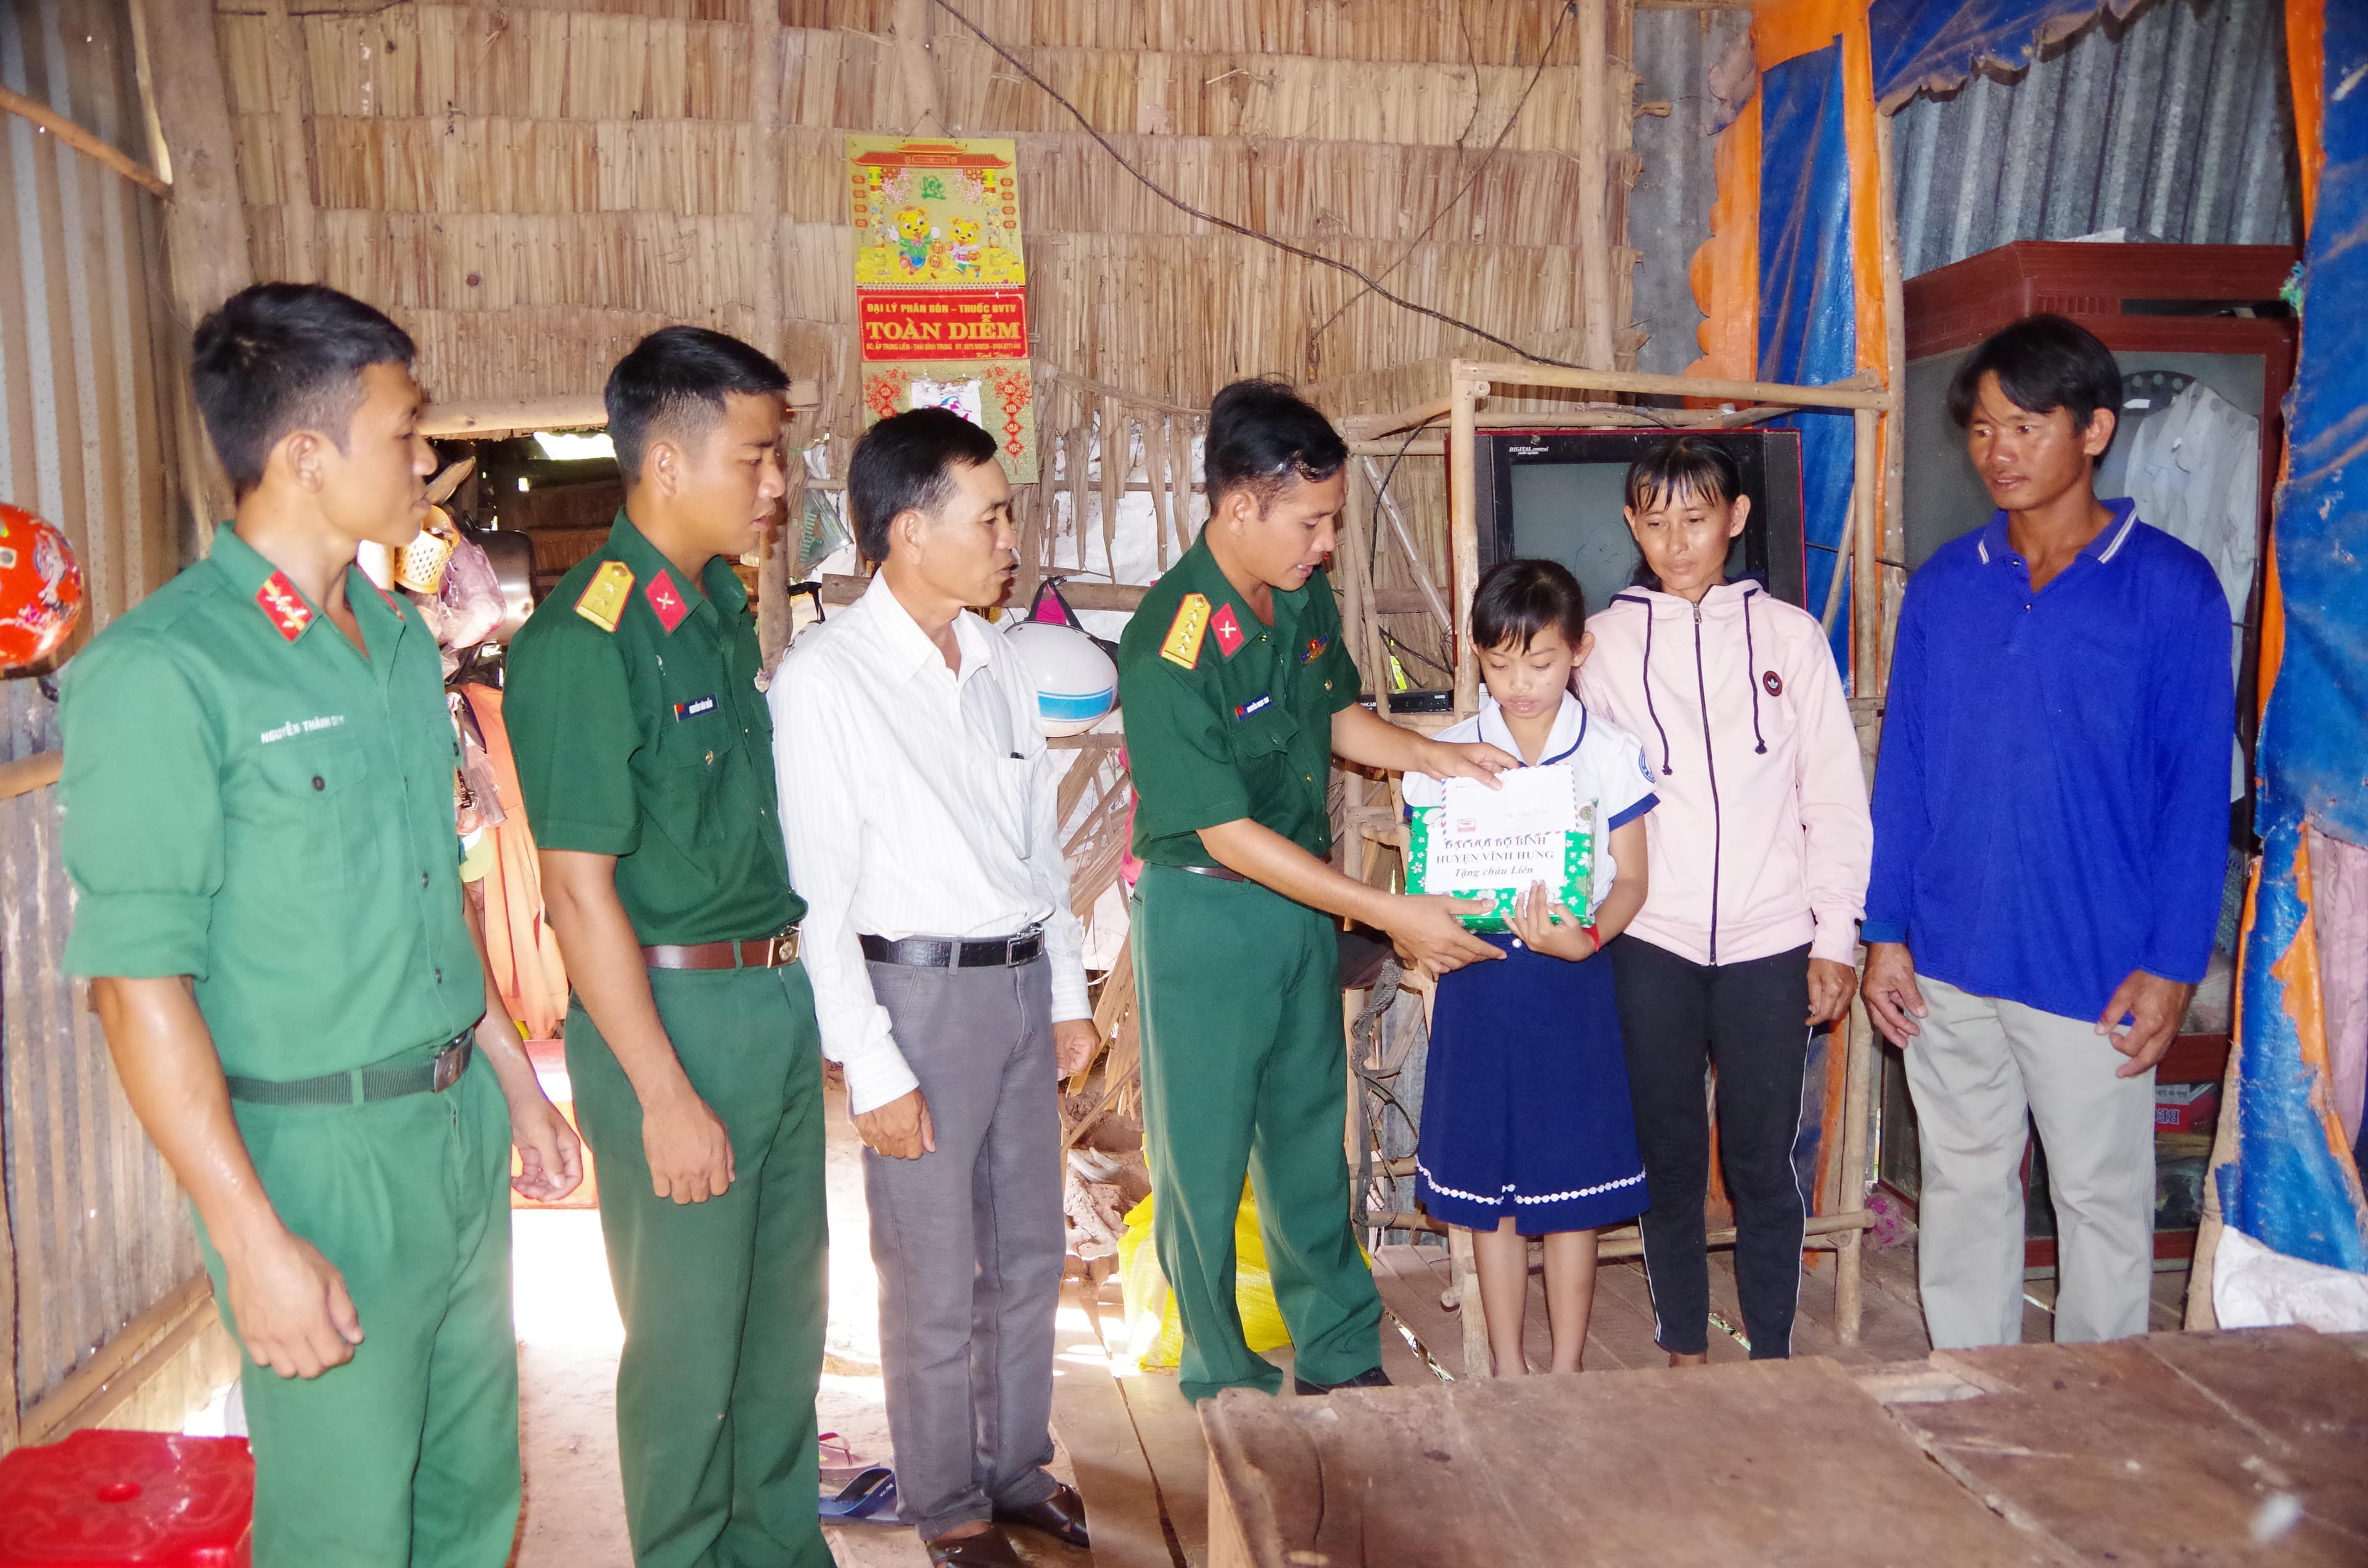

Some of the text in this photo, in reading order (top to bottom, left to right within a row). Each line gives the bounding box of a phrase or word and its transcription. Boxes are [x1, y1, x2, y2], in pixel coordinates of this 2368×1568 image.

[867, 303, 883, 314] ĐẠI
[886, 302, 897, 313] LÝ
[900, 303, 926, 313] PHÂN
[929, 303, 948, 313] BÓN
[958, 302, 990, 313] THUỐC
[992, 304, 1016, 313] BVTV
[866, 314, 1021, 340] TOÀN DIỄM
